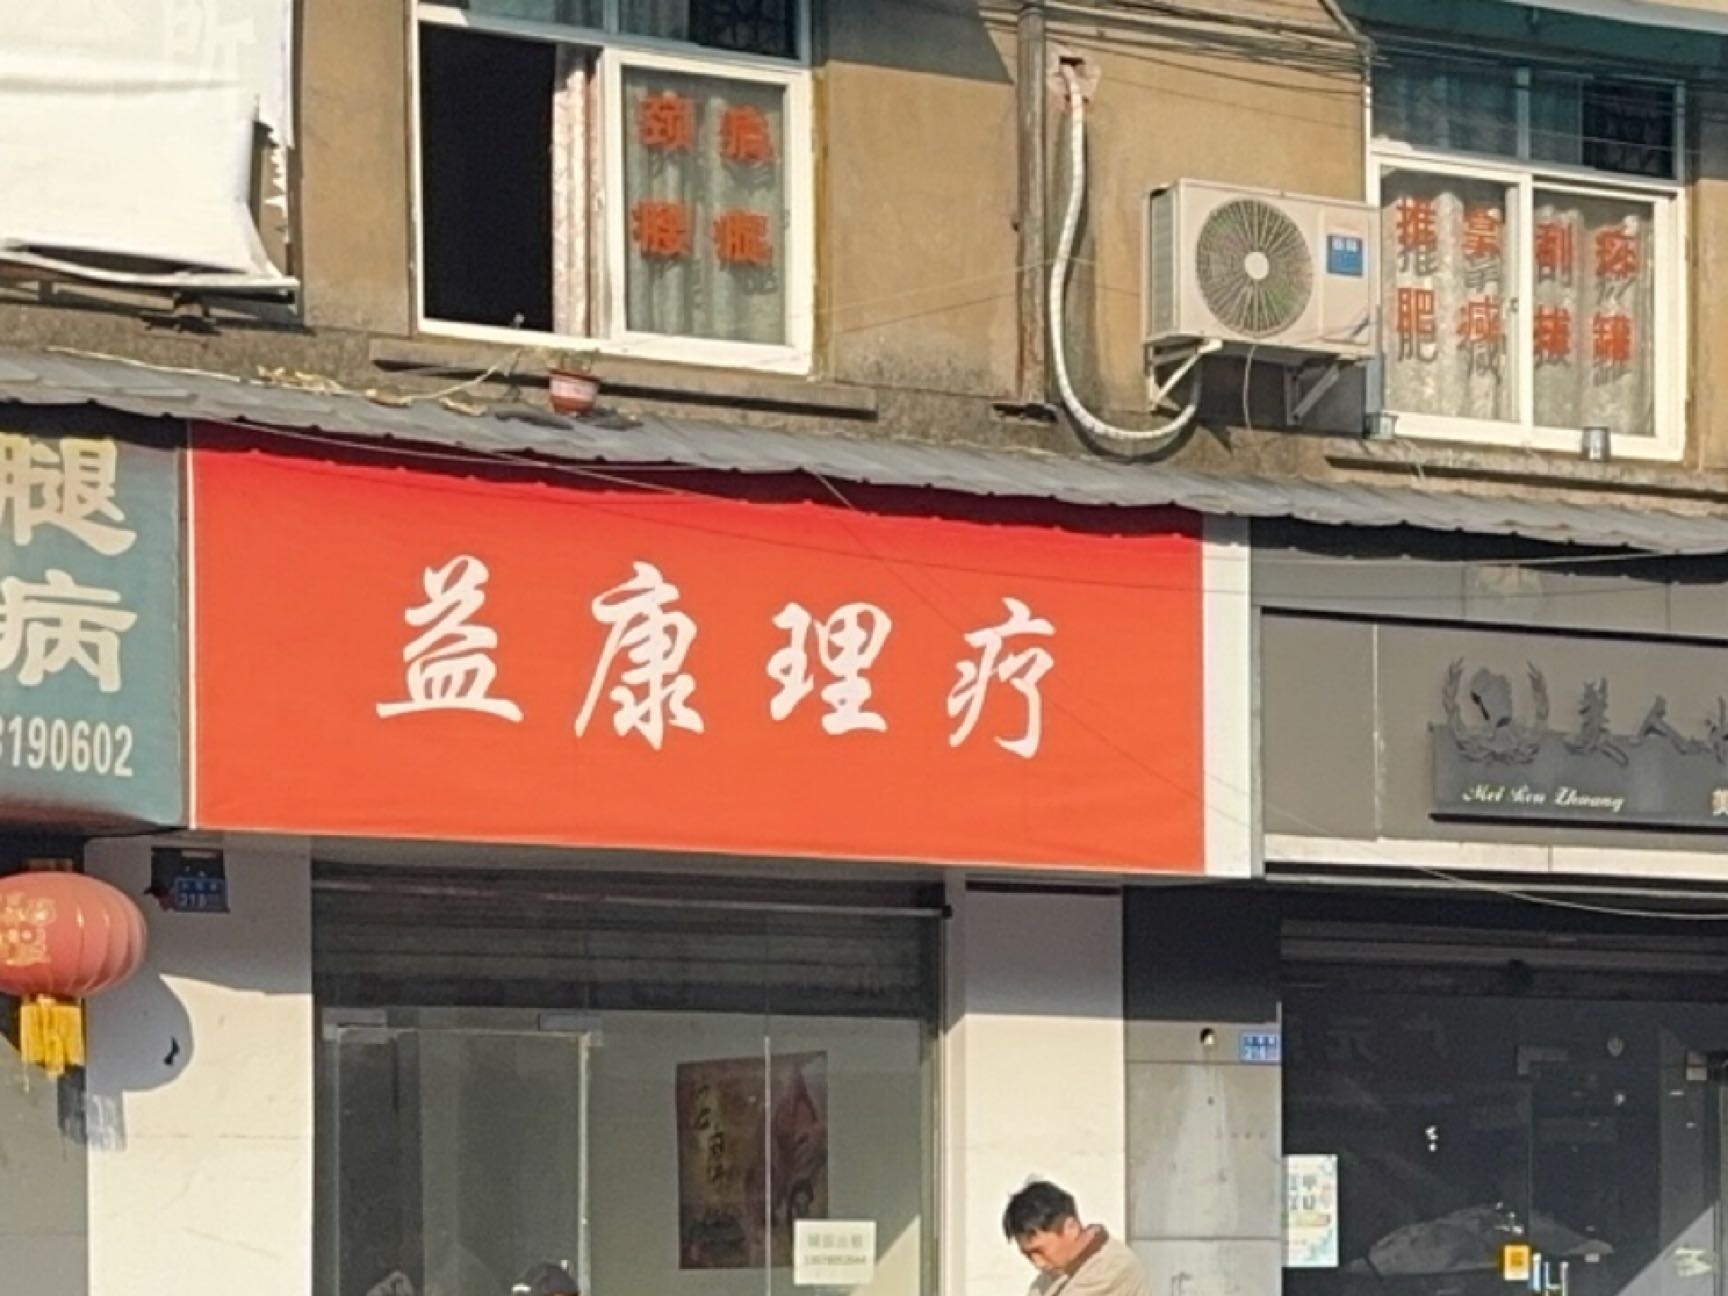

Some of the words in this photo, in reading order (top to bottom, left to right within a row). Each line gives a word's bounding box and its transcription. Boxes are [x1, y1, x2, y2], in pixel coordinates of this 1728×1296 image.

[0, 569, 137, 693] 病
[376, 555, 1056, 758] 益康理疗
